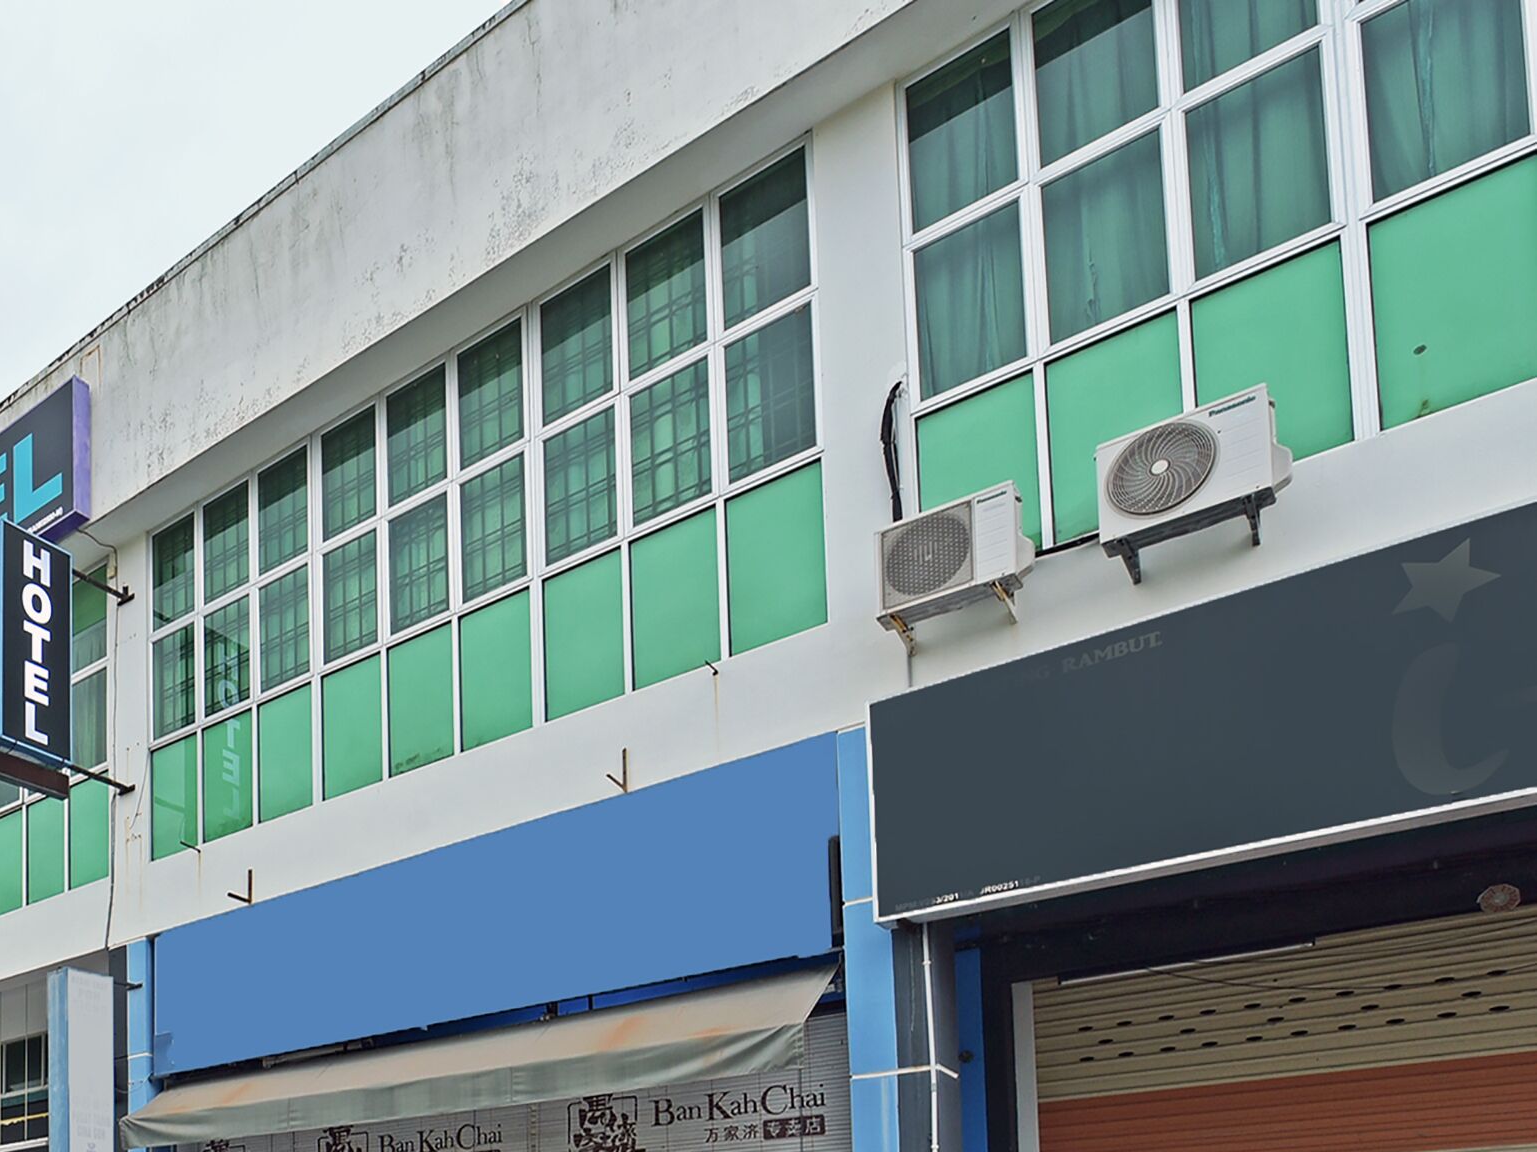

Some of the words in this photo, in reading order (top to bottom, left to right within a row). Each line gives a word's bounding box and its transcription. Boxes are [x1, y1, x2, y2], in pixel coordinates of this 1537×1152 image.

[21, 539, 53, 746] HOTEL
[651, 1097, 702, 1127] Ban
[704, 1090, 758, 1122] Kah
[760, 1084, 826, 1116] Chai
[456, 1123, 503, 1150] Chai
[704, 1122, 760, 1144] 万家济
[763, 1115, 825, 1140] 专卖店
